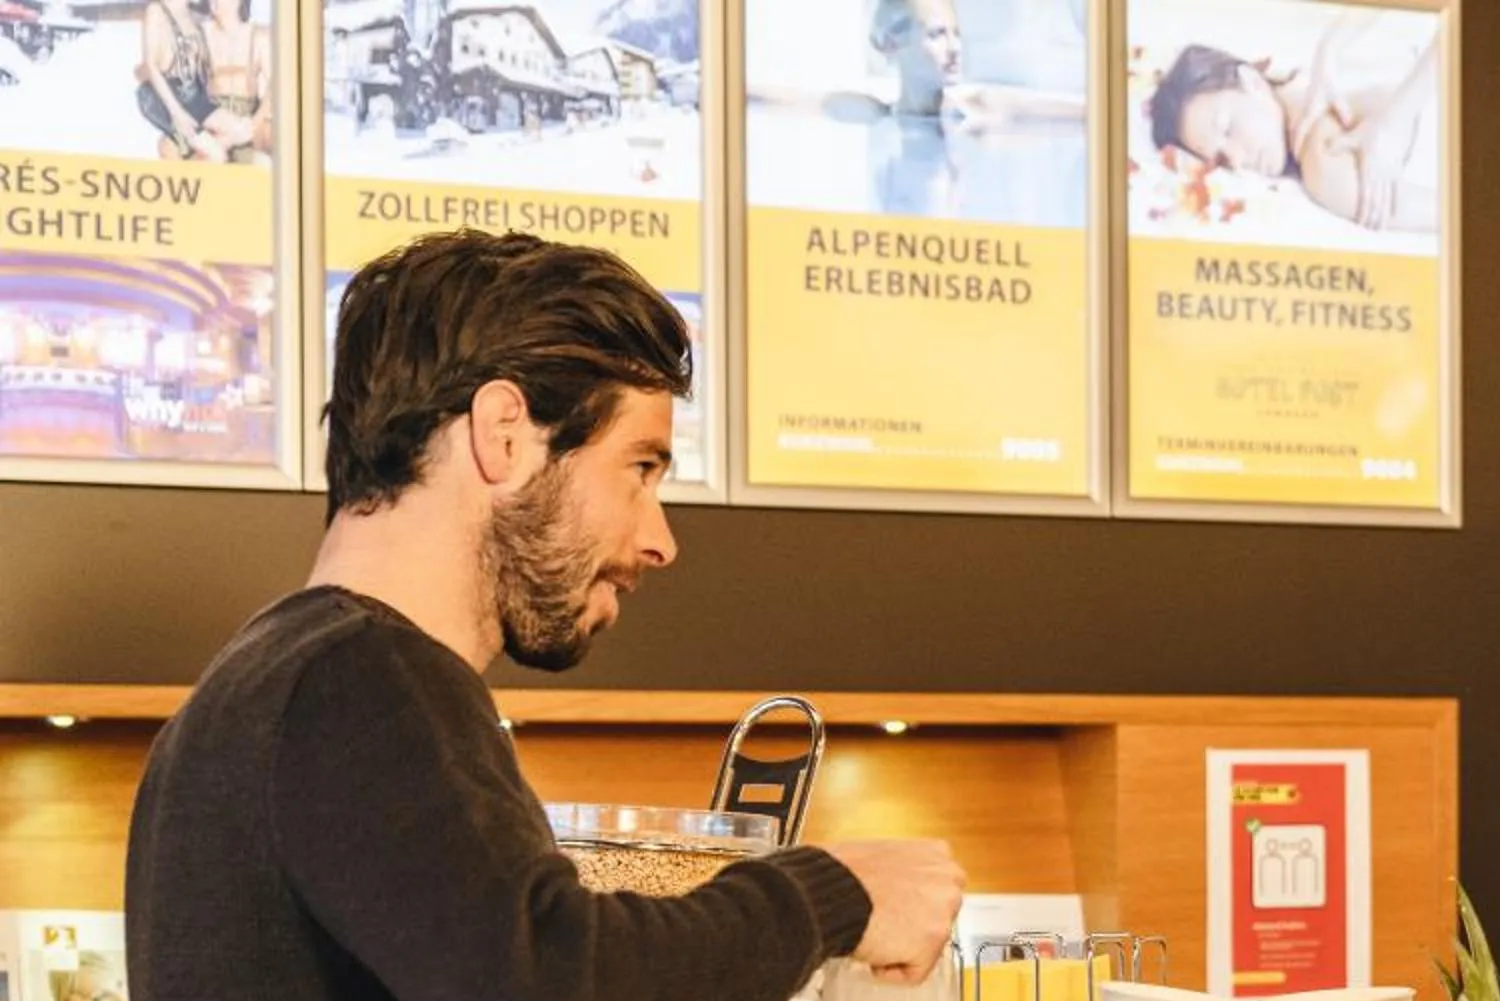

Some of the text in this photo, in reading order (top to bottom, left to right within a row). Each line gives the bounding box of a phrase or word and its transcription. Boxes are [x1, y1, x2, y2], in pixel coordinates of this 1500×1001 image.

[0, 207, 175, 246] GHTLIFE
[358, 190, 670, 238] ZOLLFREI SHOPPEN
[806, 226, 1031, 268] ALPENQUELL
[804, 265, 1032, 305] ERLEBNISBAD
[1194, 257, 1375, 297] MASSAGEN,
[1156, 291, 1412, 333] BEAUTY, FITNESS
[778, 414, 923, 433] INFORMATIONEN
